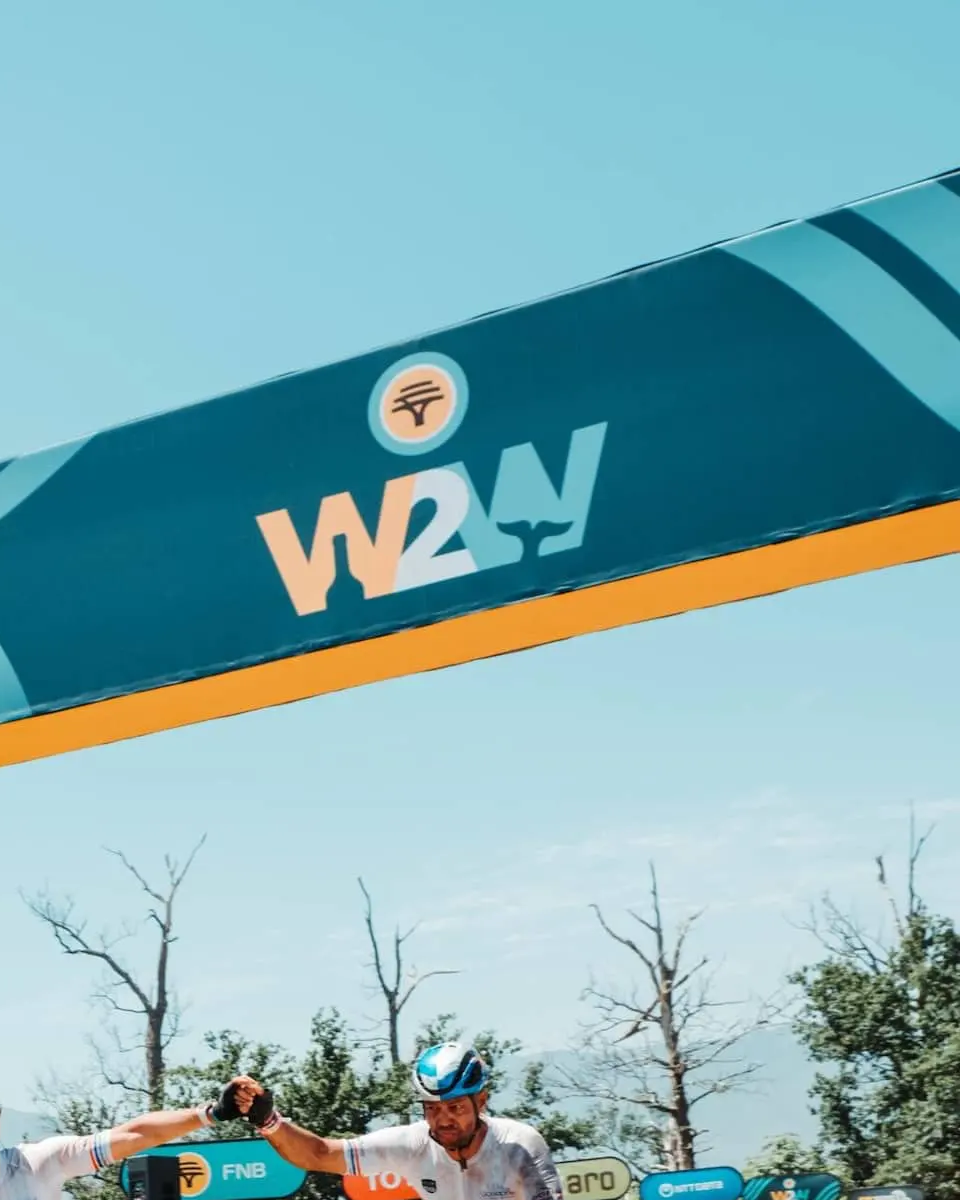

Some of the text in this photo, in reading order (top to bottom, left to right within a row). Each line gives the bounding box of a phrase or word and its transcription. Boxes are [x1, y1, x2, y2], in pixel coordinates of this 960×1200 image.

[255, 421, 608, 617] W2W
[222, 1162, 267, 1181] FNB
[566, 1171, 615, 1194] aro
